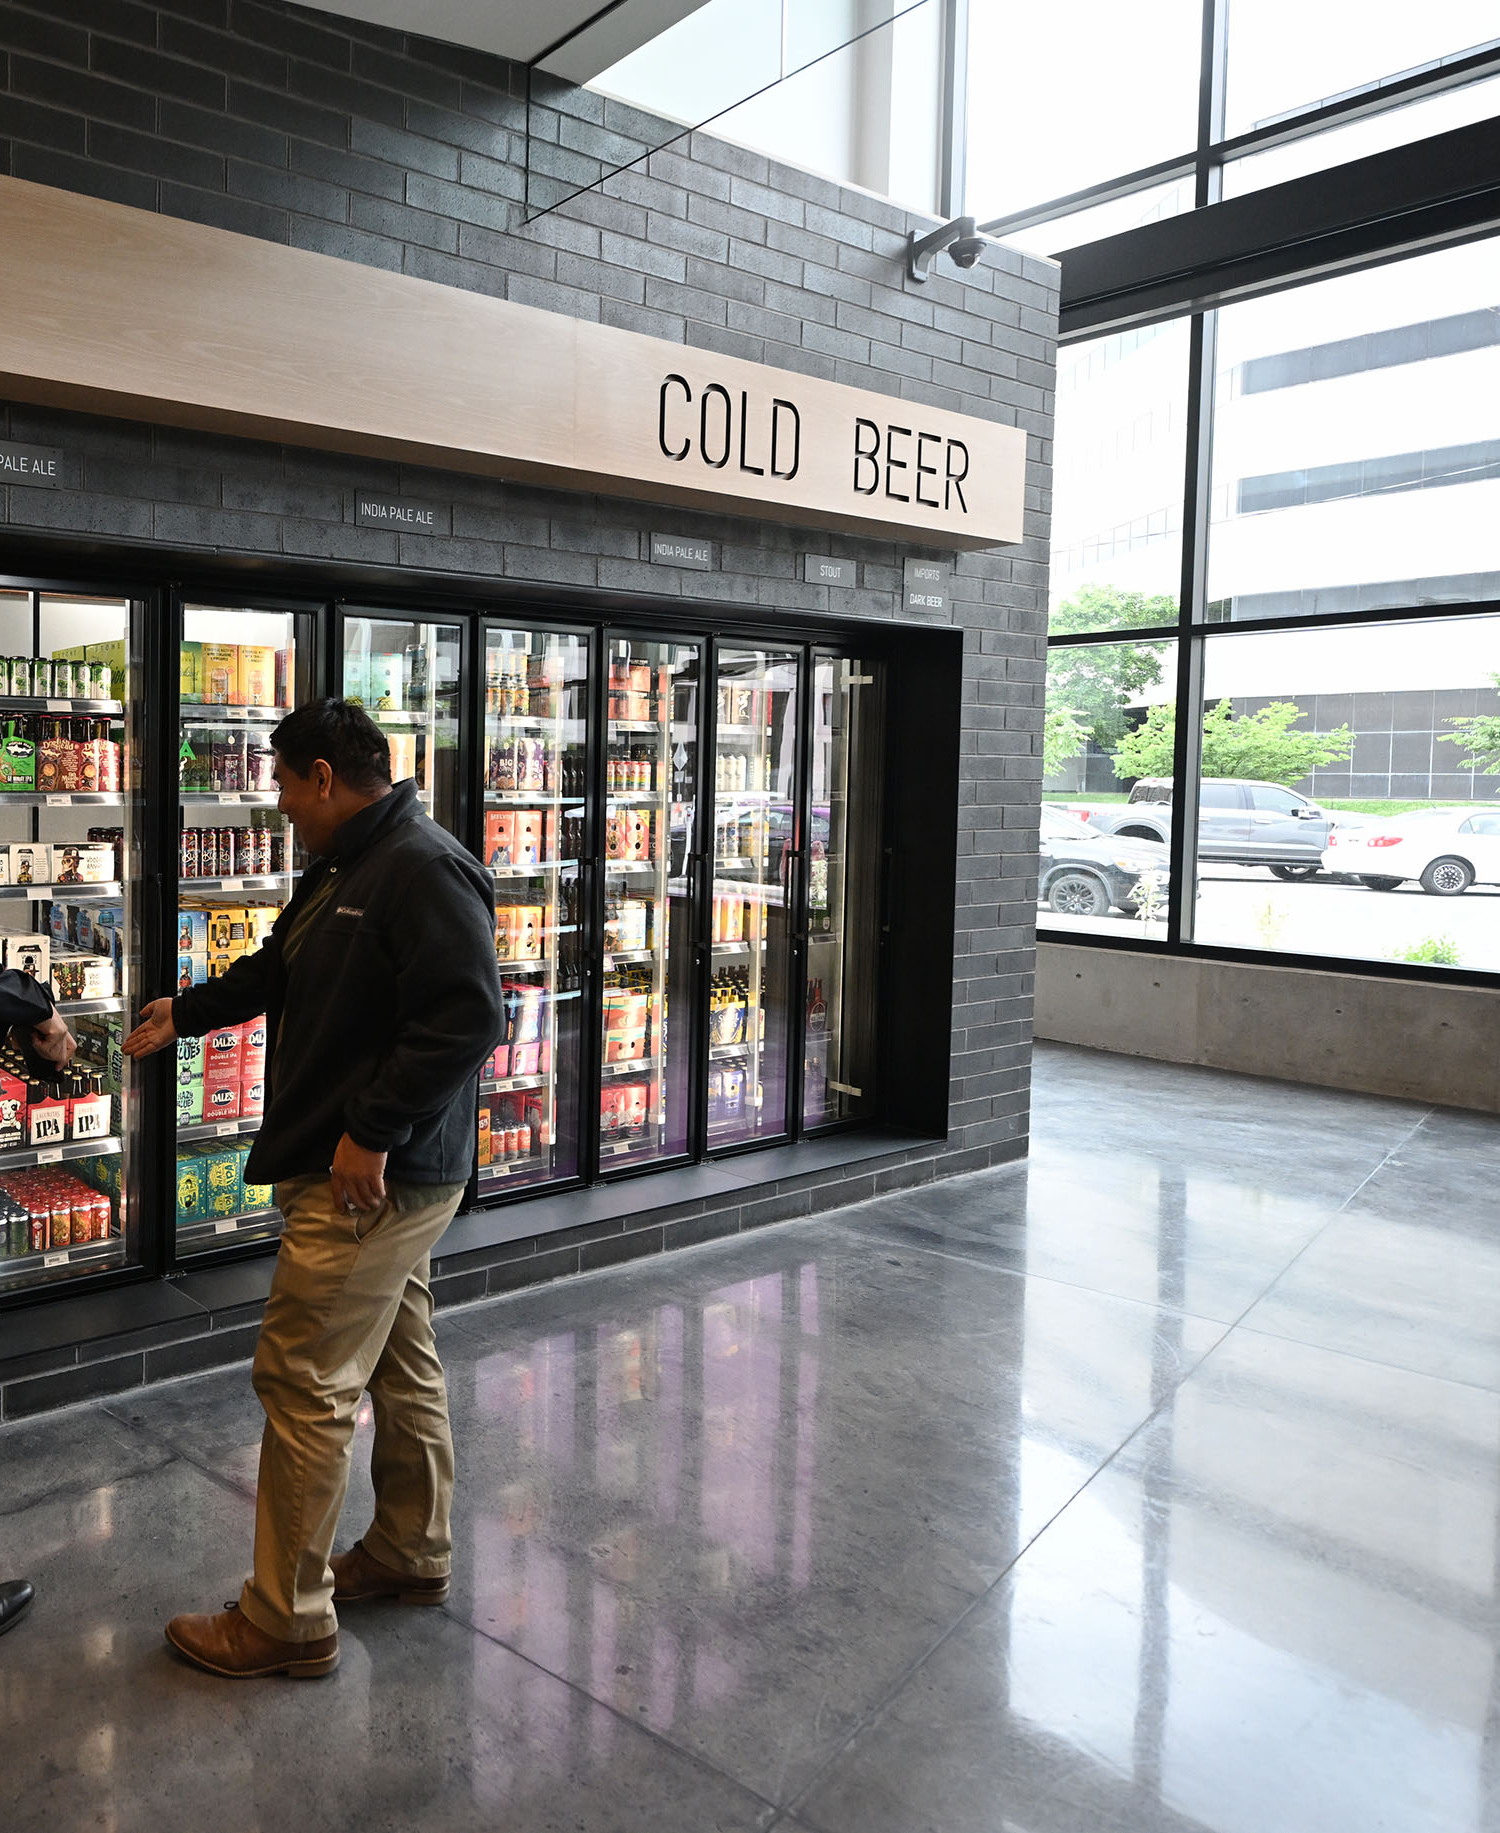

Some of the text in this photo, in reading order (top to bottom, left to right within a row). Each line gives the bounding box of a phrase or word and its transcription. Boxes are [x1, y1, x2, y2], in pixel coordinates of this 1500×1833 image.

[659, 373, 969, 513] COLD BEER
[32, 459, 56, 476] ALE
[361, 502, 433, 525] INDIA PALE ALE
[654, 543, 708, 562] INDIA PALE ALE
[820, 564, 842, 578] STOUT
[914, 567, 940, 581] IMPORTS
[909, 593, 943, 608] DARK BEER
[35, 1118, 60, 1139] IPA
[78, 1114, 100, 1133] IPA
